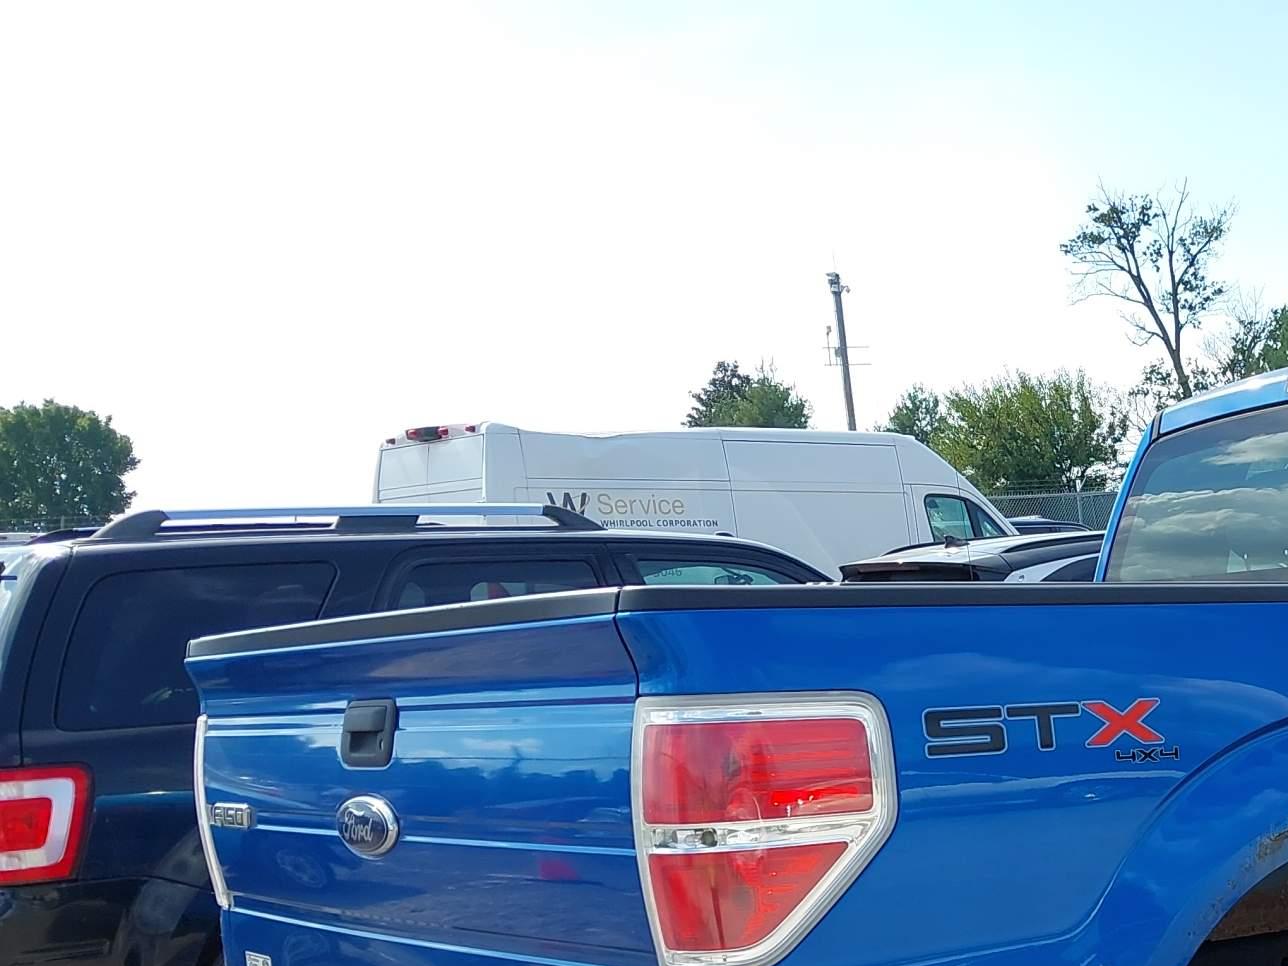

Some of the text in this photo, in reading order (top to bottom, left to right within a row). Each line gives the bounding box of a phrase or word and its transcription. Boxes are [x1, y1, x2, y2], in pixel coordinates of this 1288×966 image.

[597, 493, 685, 515] Service
[600, 519, 719, 528] WHIRLPOOL CORPORATION
[922, 697, 1166, 759] STX
[342, 807, 374, 843] Ford
